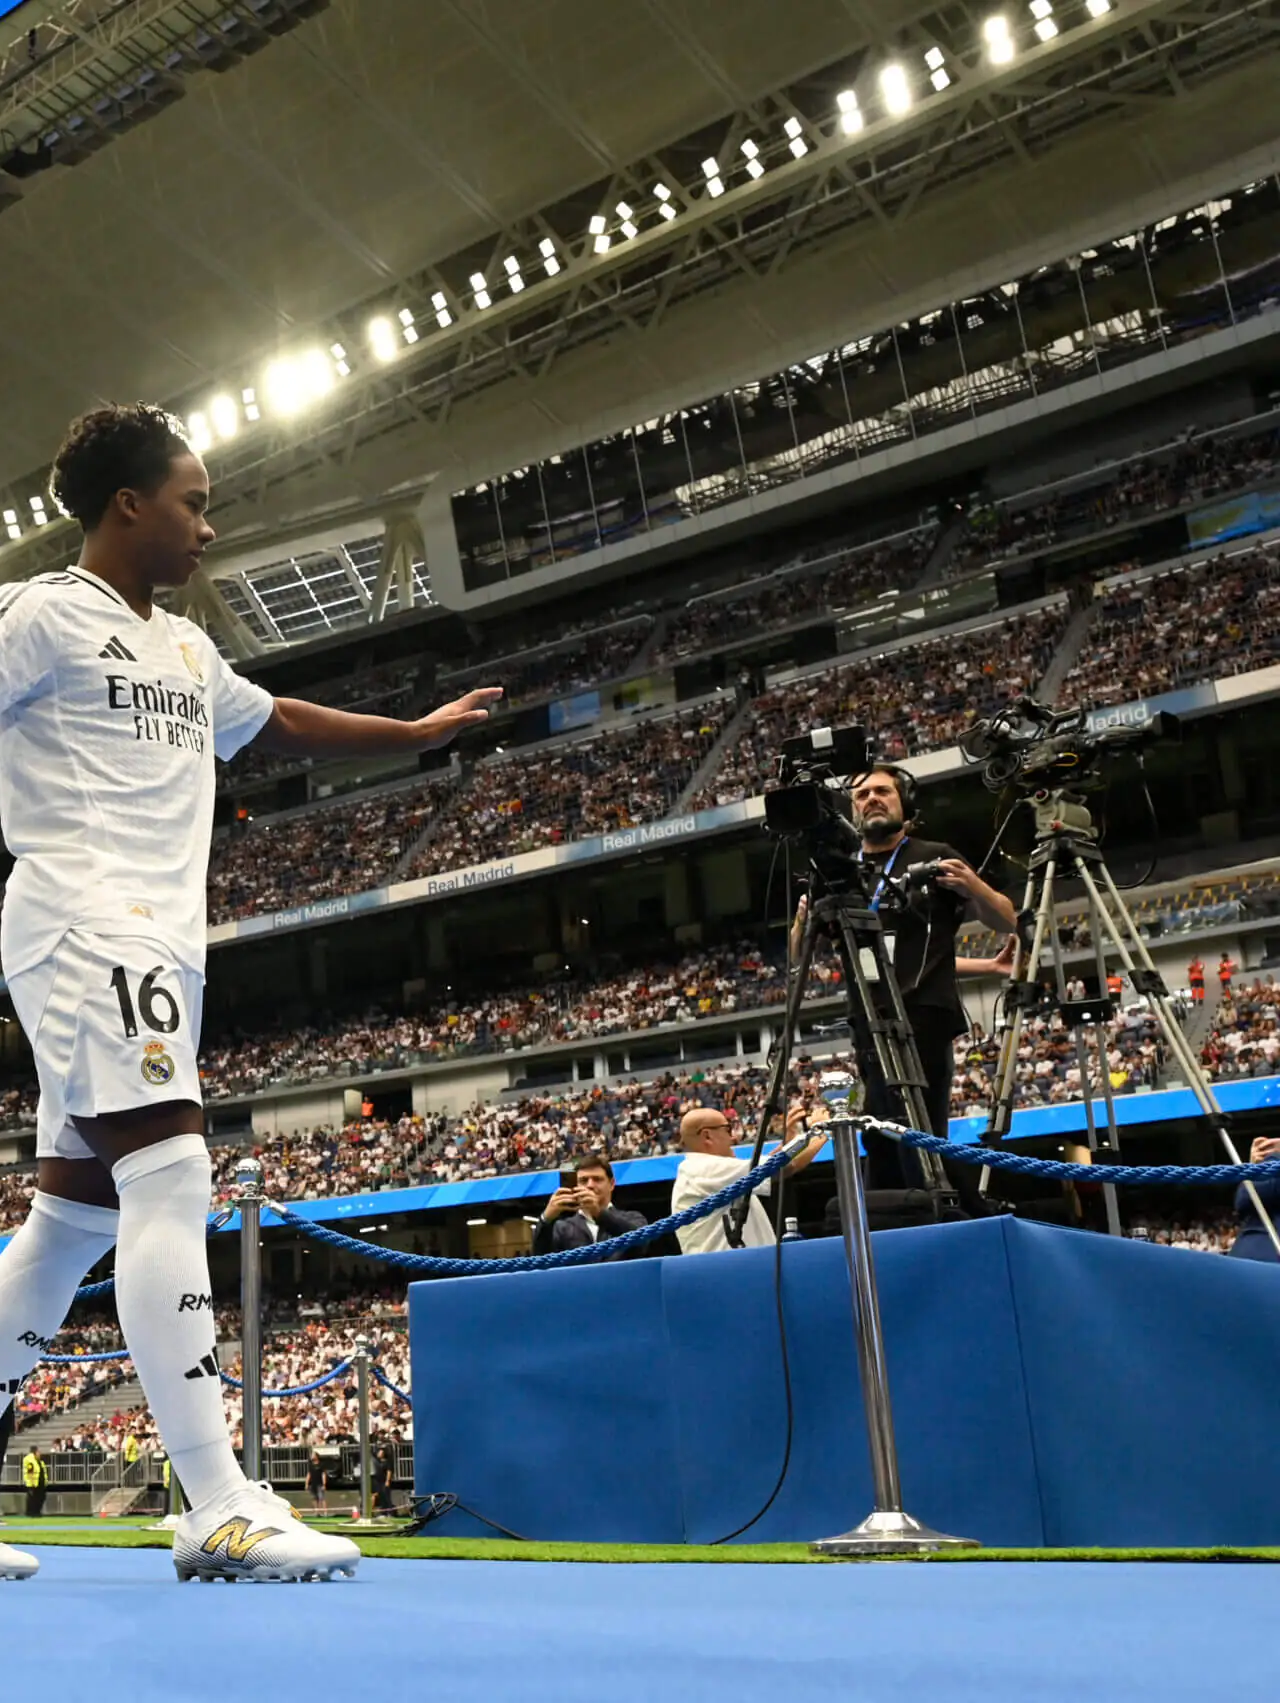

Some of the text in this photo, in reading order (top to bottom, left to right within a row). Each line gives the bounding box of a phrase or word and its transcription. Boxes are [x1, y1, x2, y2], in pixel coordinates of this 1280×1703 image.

[105, 674, 209, 728] Emirates
[133, 715, 204, 756] FLY BETTER
[601, 817, 696, 851] Real Madrid
[427, 864, 514, 895] Real Madrid
[274, 900, 349, 928] Real Madrid
[109, 965, 181, 1038] 16
